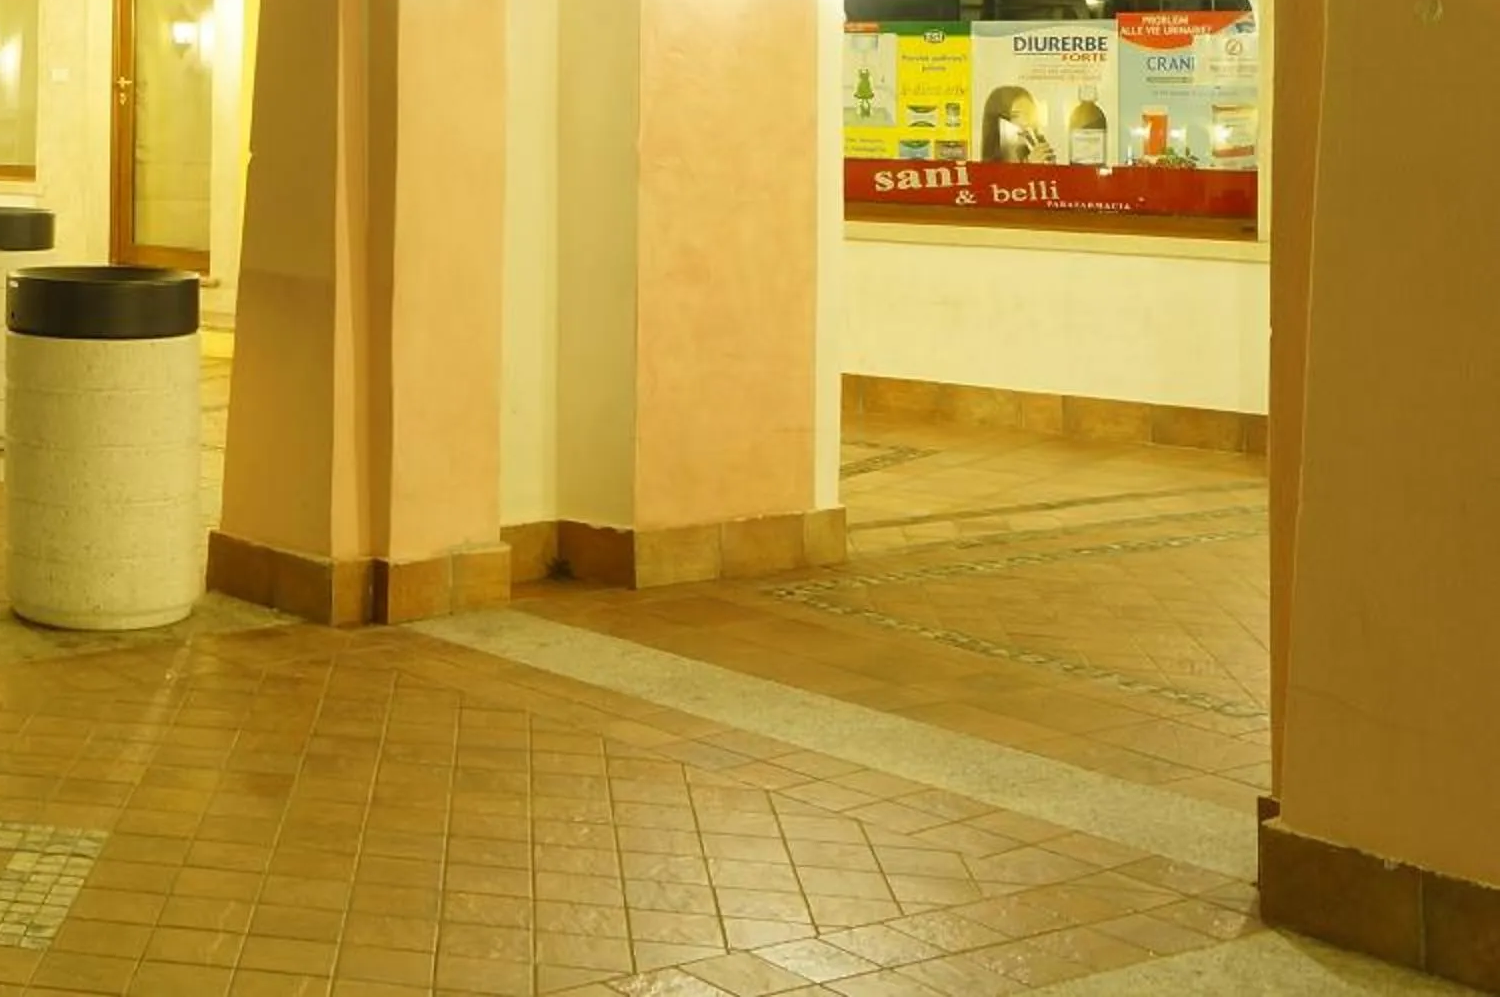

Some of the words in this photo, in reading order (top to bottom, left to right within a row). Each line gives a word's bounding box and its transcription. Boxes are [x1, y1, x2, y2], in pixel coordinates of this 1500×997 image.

[1012, 36, 1109, 52] DIURERBE
[1061, 52, 1108, 62] FORTE
[874, 160, 972, 192] sani
[955, 188, 977, 206] &
[989, 180, 1061, 203] belli
